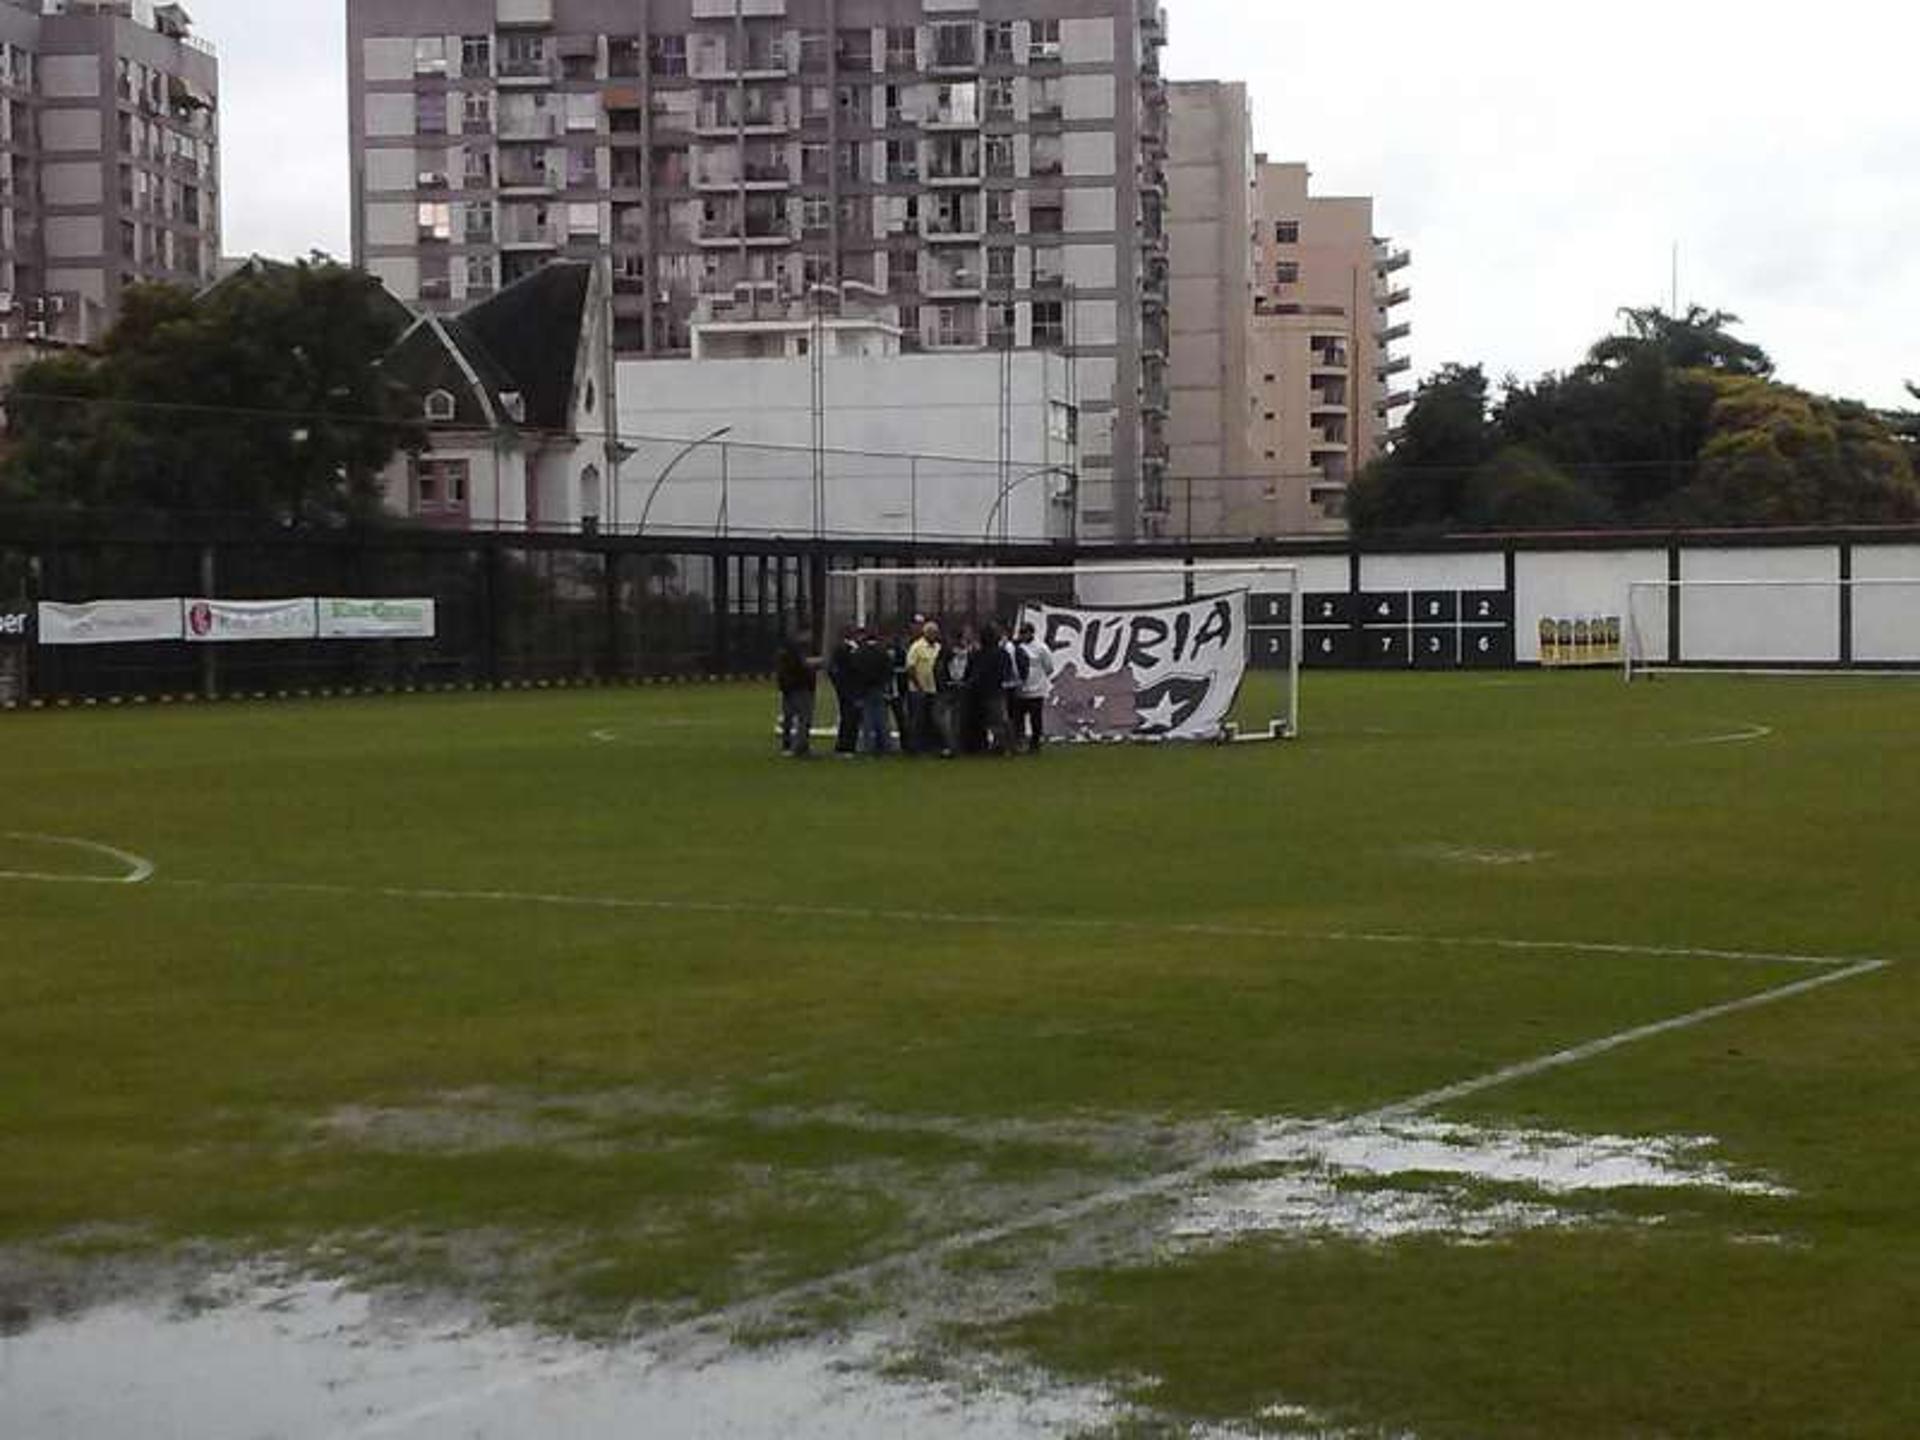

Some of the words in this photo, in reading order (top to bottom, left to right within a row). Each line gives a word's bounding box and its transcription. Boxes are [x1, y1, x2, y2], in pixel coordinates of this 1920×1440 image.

[1323, 601, 1334, 617] 2
[1378, 601, 1390, 616] 4
[1478, 601, 1490, 616] 2
[1045, 600, 1231, 670] FÚRIA
[1269, 638, 1280, 654] 3
[1382, 637, 1392, 652] 7
[1429, 637, 1440, 652] 3
[1478, 637, 1490, 652] 6
